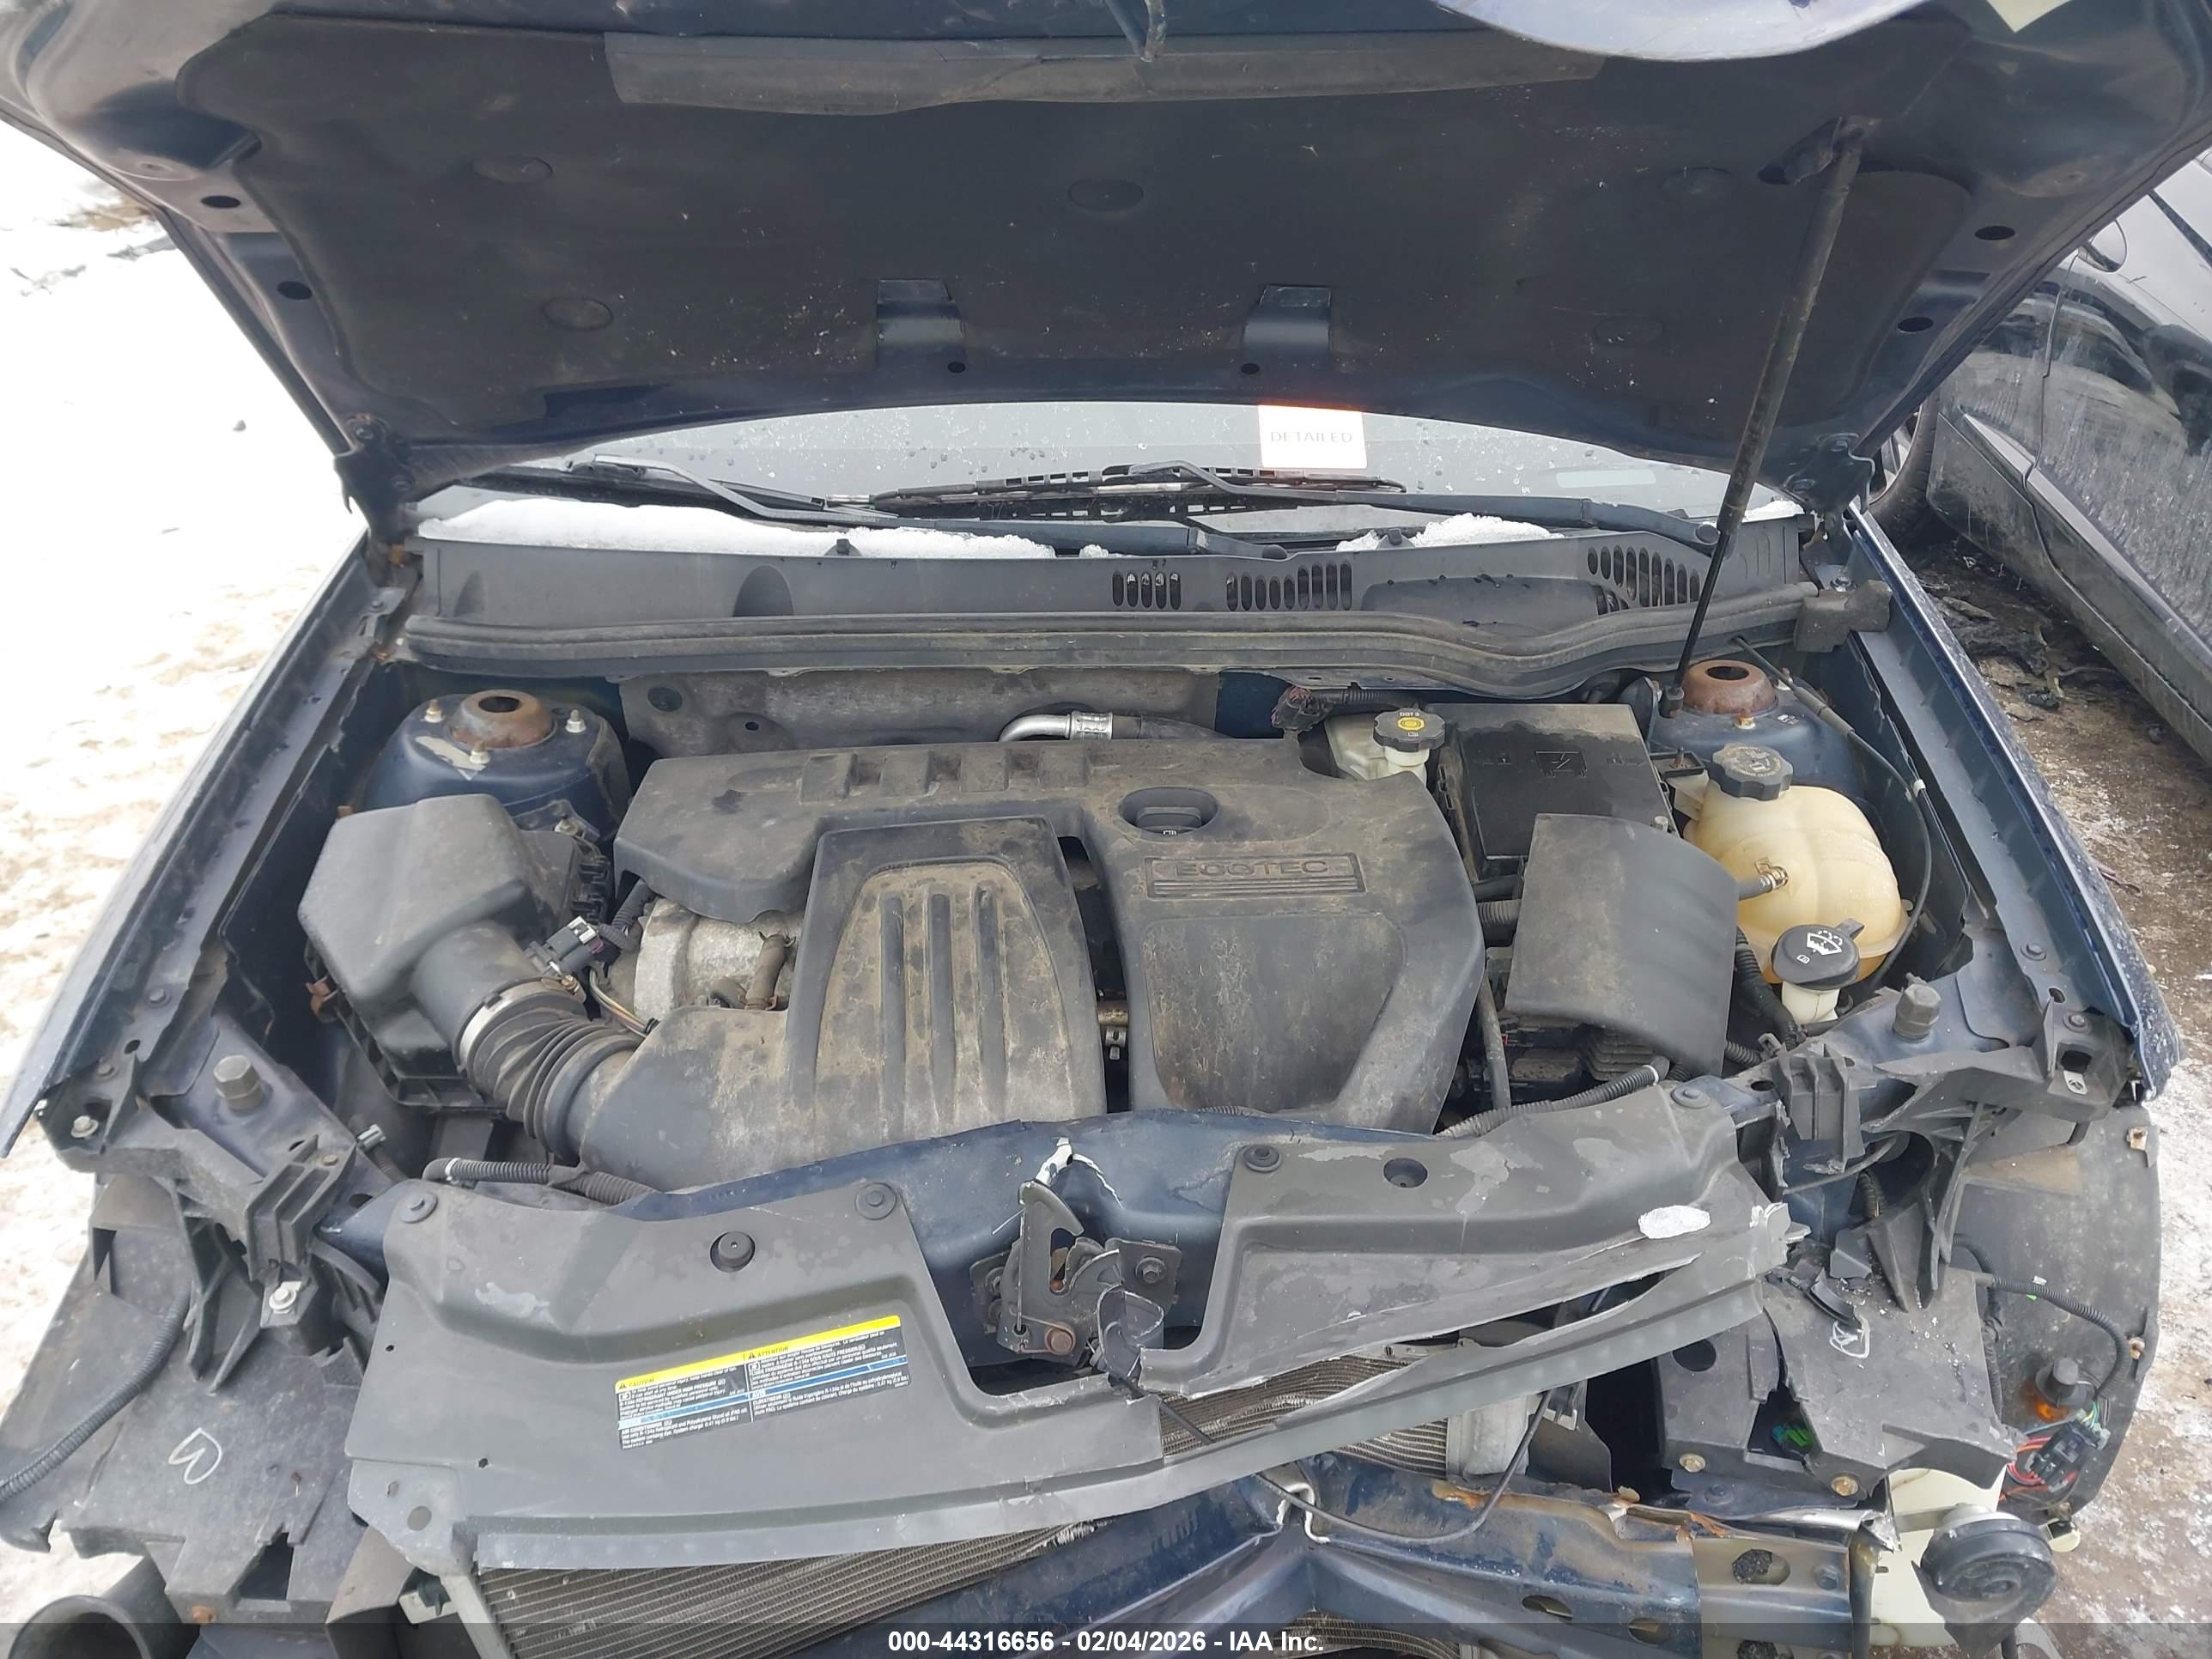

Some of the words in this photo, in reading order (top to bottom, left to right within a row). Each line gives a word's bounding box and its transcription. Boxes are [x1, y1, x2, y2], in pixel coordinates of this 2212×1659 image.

[1270, 431, 1353, 443] DETAILED
[1176, 860, 1328, 878] ECOTEC
[757, 1346, 788, 1358] ATTENTION
[629, 1377, 654, 1388] CAUTION
